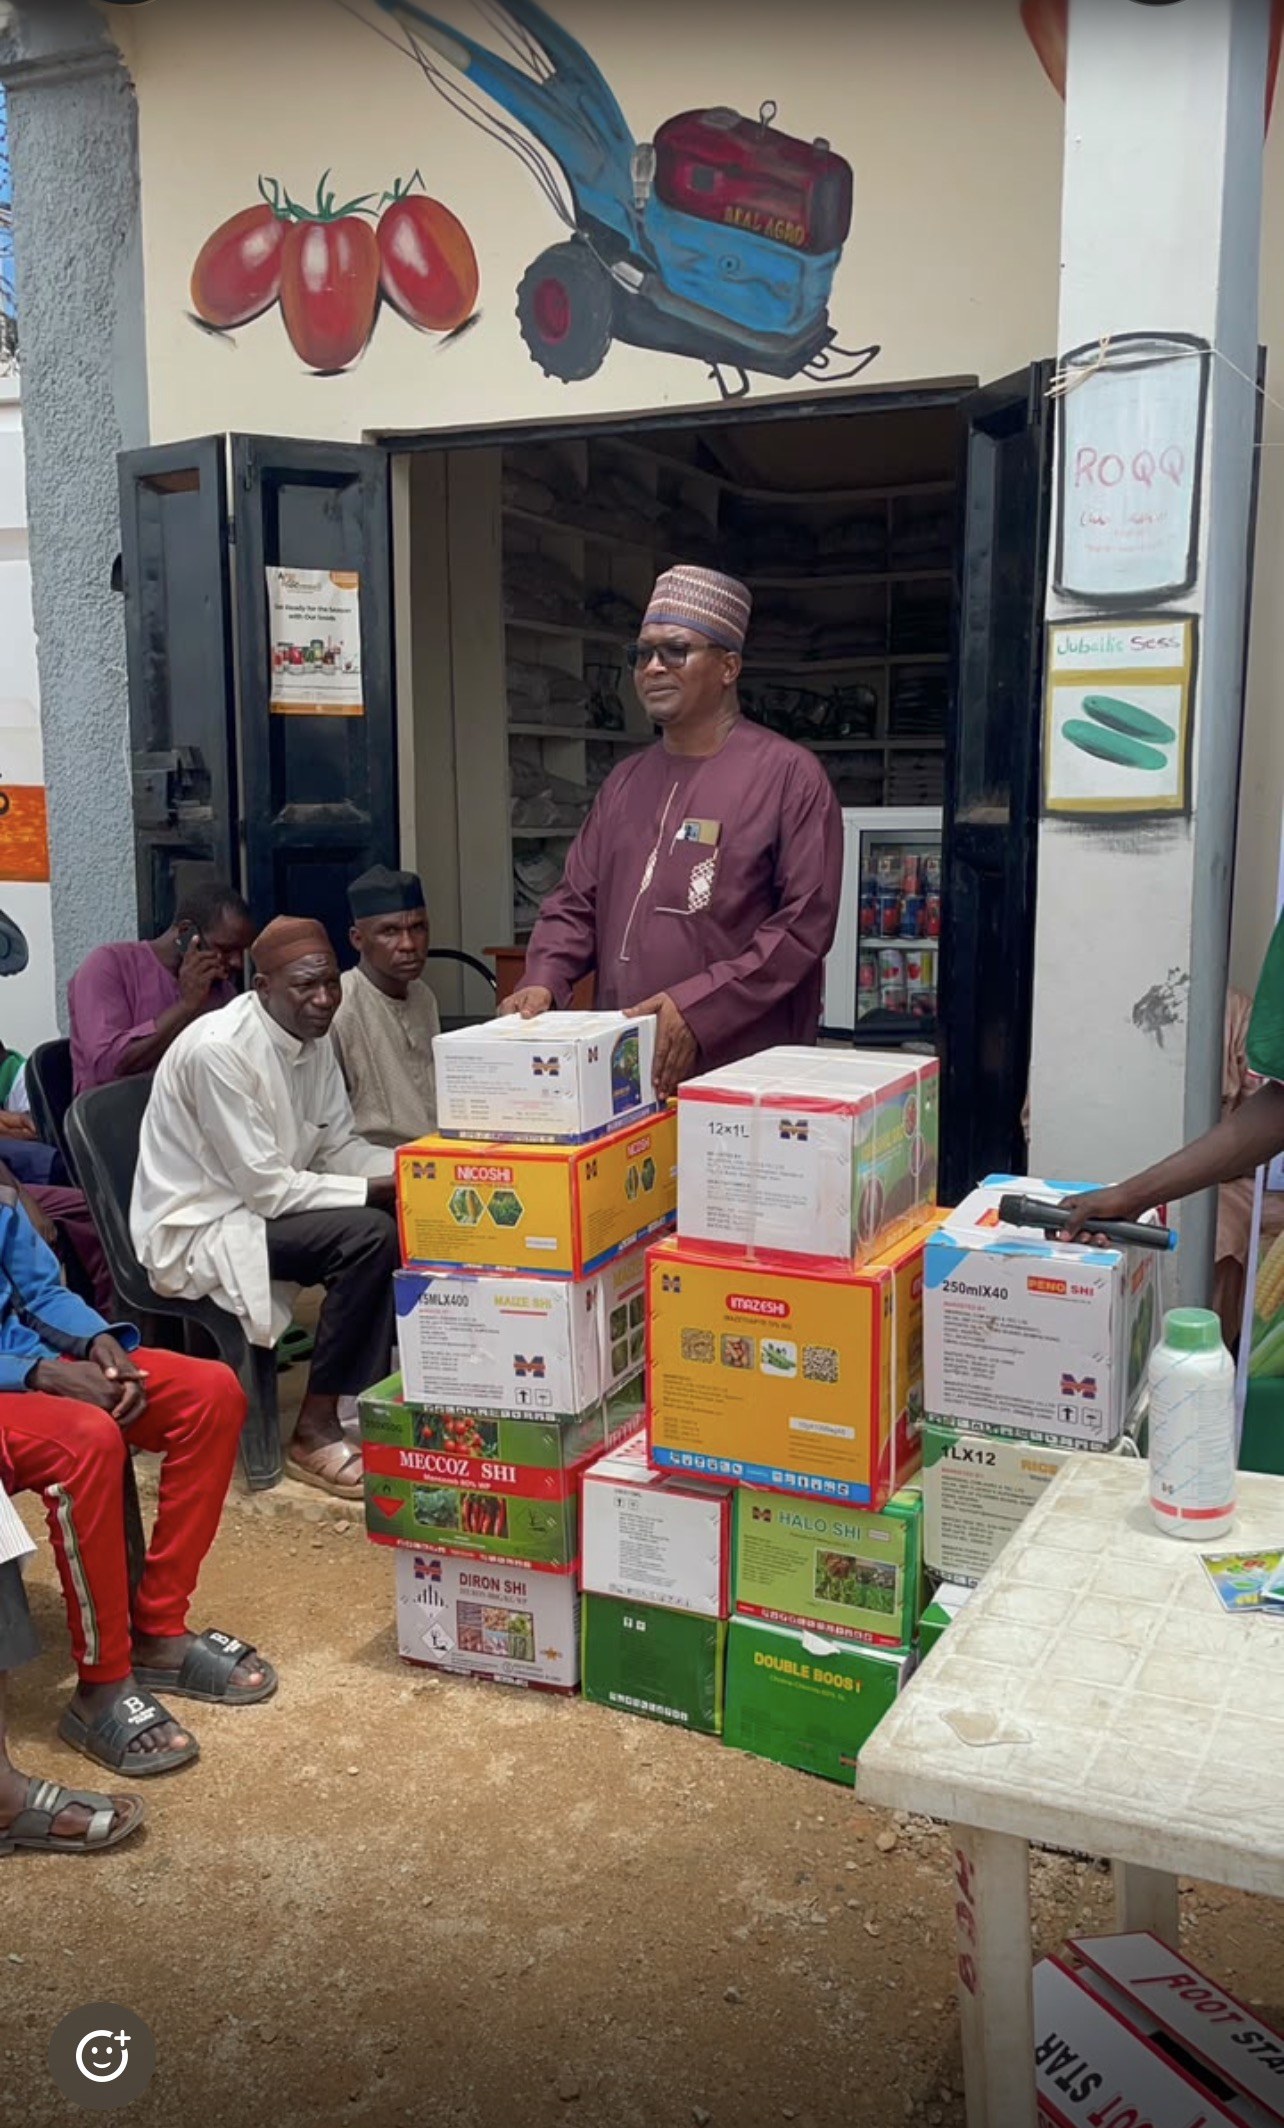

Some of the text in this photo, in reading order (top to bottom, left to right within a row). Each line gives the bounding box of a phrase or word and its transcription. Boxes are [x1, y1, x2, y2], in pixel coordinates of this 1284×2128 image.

[456, 1165, 512, 1182] NICOSHI
[942, 1279, 1009, 1300] 250mlX40
[1070, 1284, 1095, 1297] SHI
[399, 1450, 517, 1484] MECCOZ SHI
[941, 1443, 997, 1467] 1LX12
[778, 1510, 828, 1533] HALO
[832, 1521, 861, 1541] SHI
[459, 1572, 501, 1593] DIRON
[503, 1581, 527, 1597] SHI
[753, 1651, 811, 1679] DOUBLE
[1230, 2030, 1284, 2074] STA
